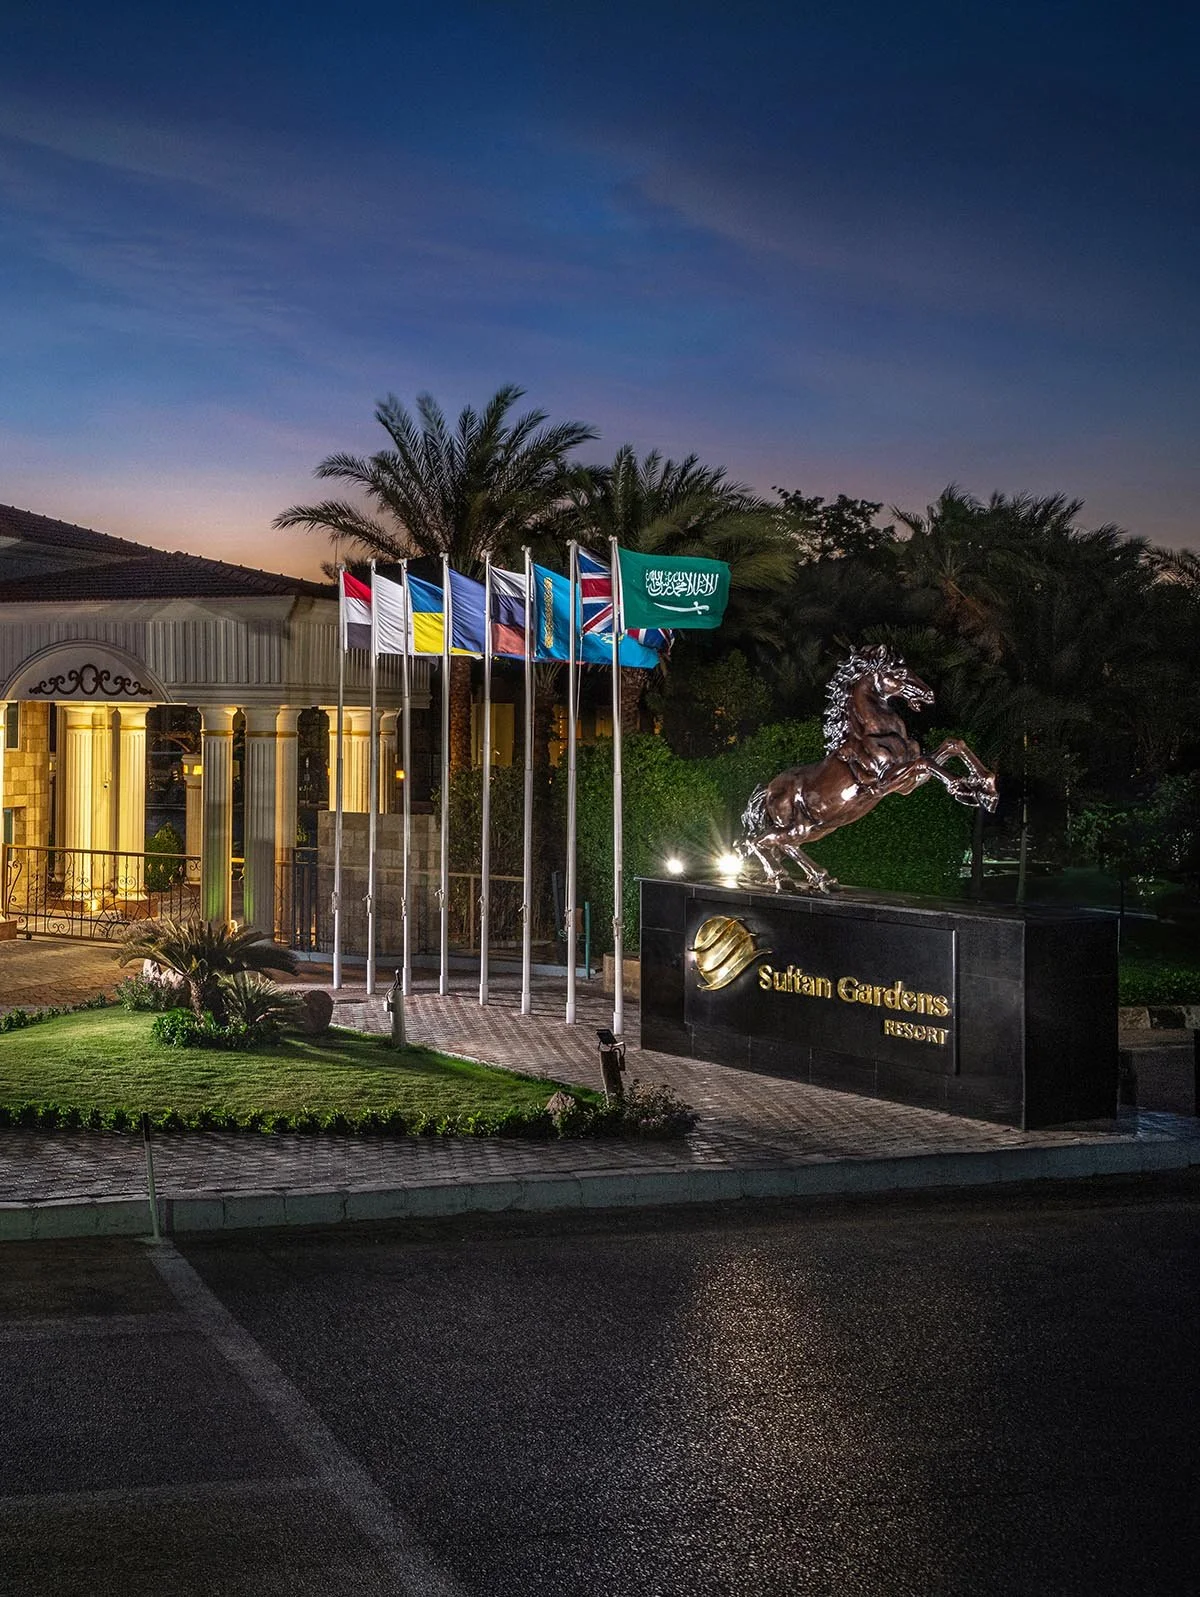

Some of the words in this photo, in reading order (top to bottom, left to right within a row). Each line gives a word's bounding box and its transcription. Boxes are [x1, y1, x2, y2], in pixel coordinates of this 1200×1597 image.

[758, 964, 832, 999] Sultan
[836, 976, 950, 1017] Gardens
[883, 1018, 949, 1045] RESORT
